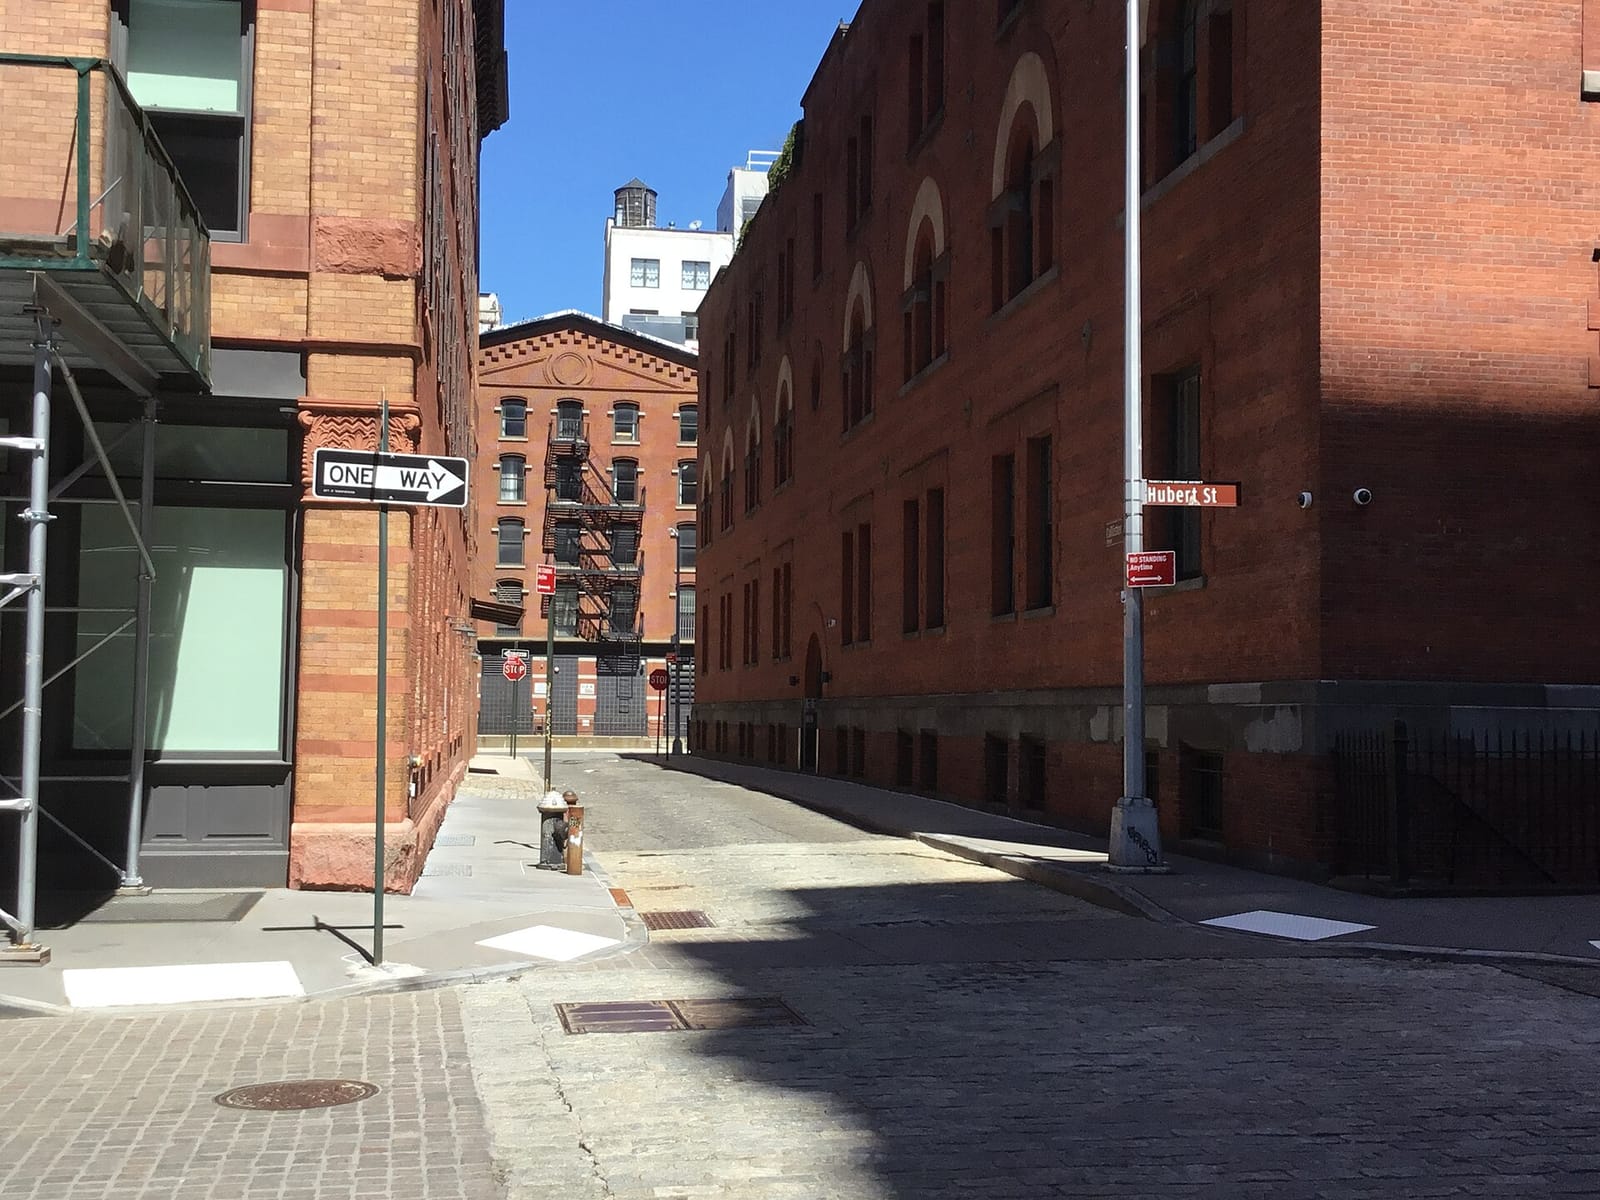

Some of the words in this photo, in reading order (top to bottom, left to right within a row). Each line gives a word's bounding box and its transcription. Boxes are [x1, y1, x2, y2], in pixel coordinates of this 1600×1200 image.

[329, 465, 374, 485] ONE
[400, 470, 447, 490] WAY
[1148, 486, 1198, 504] Hubert
[1203, 487, 1218, 504] St
[1139, 555, 1167, 563] STANDING
[1129, 564, 1153, 572] Anytime
